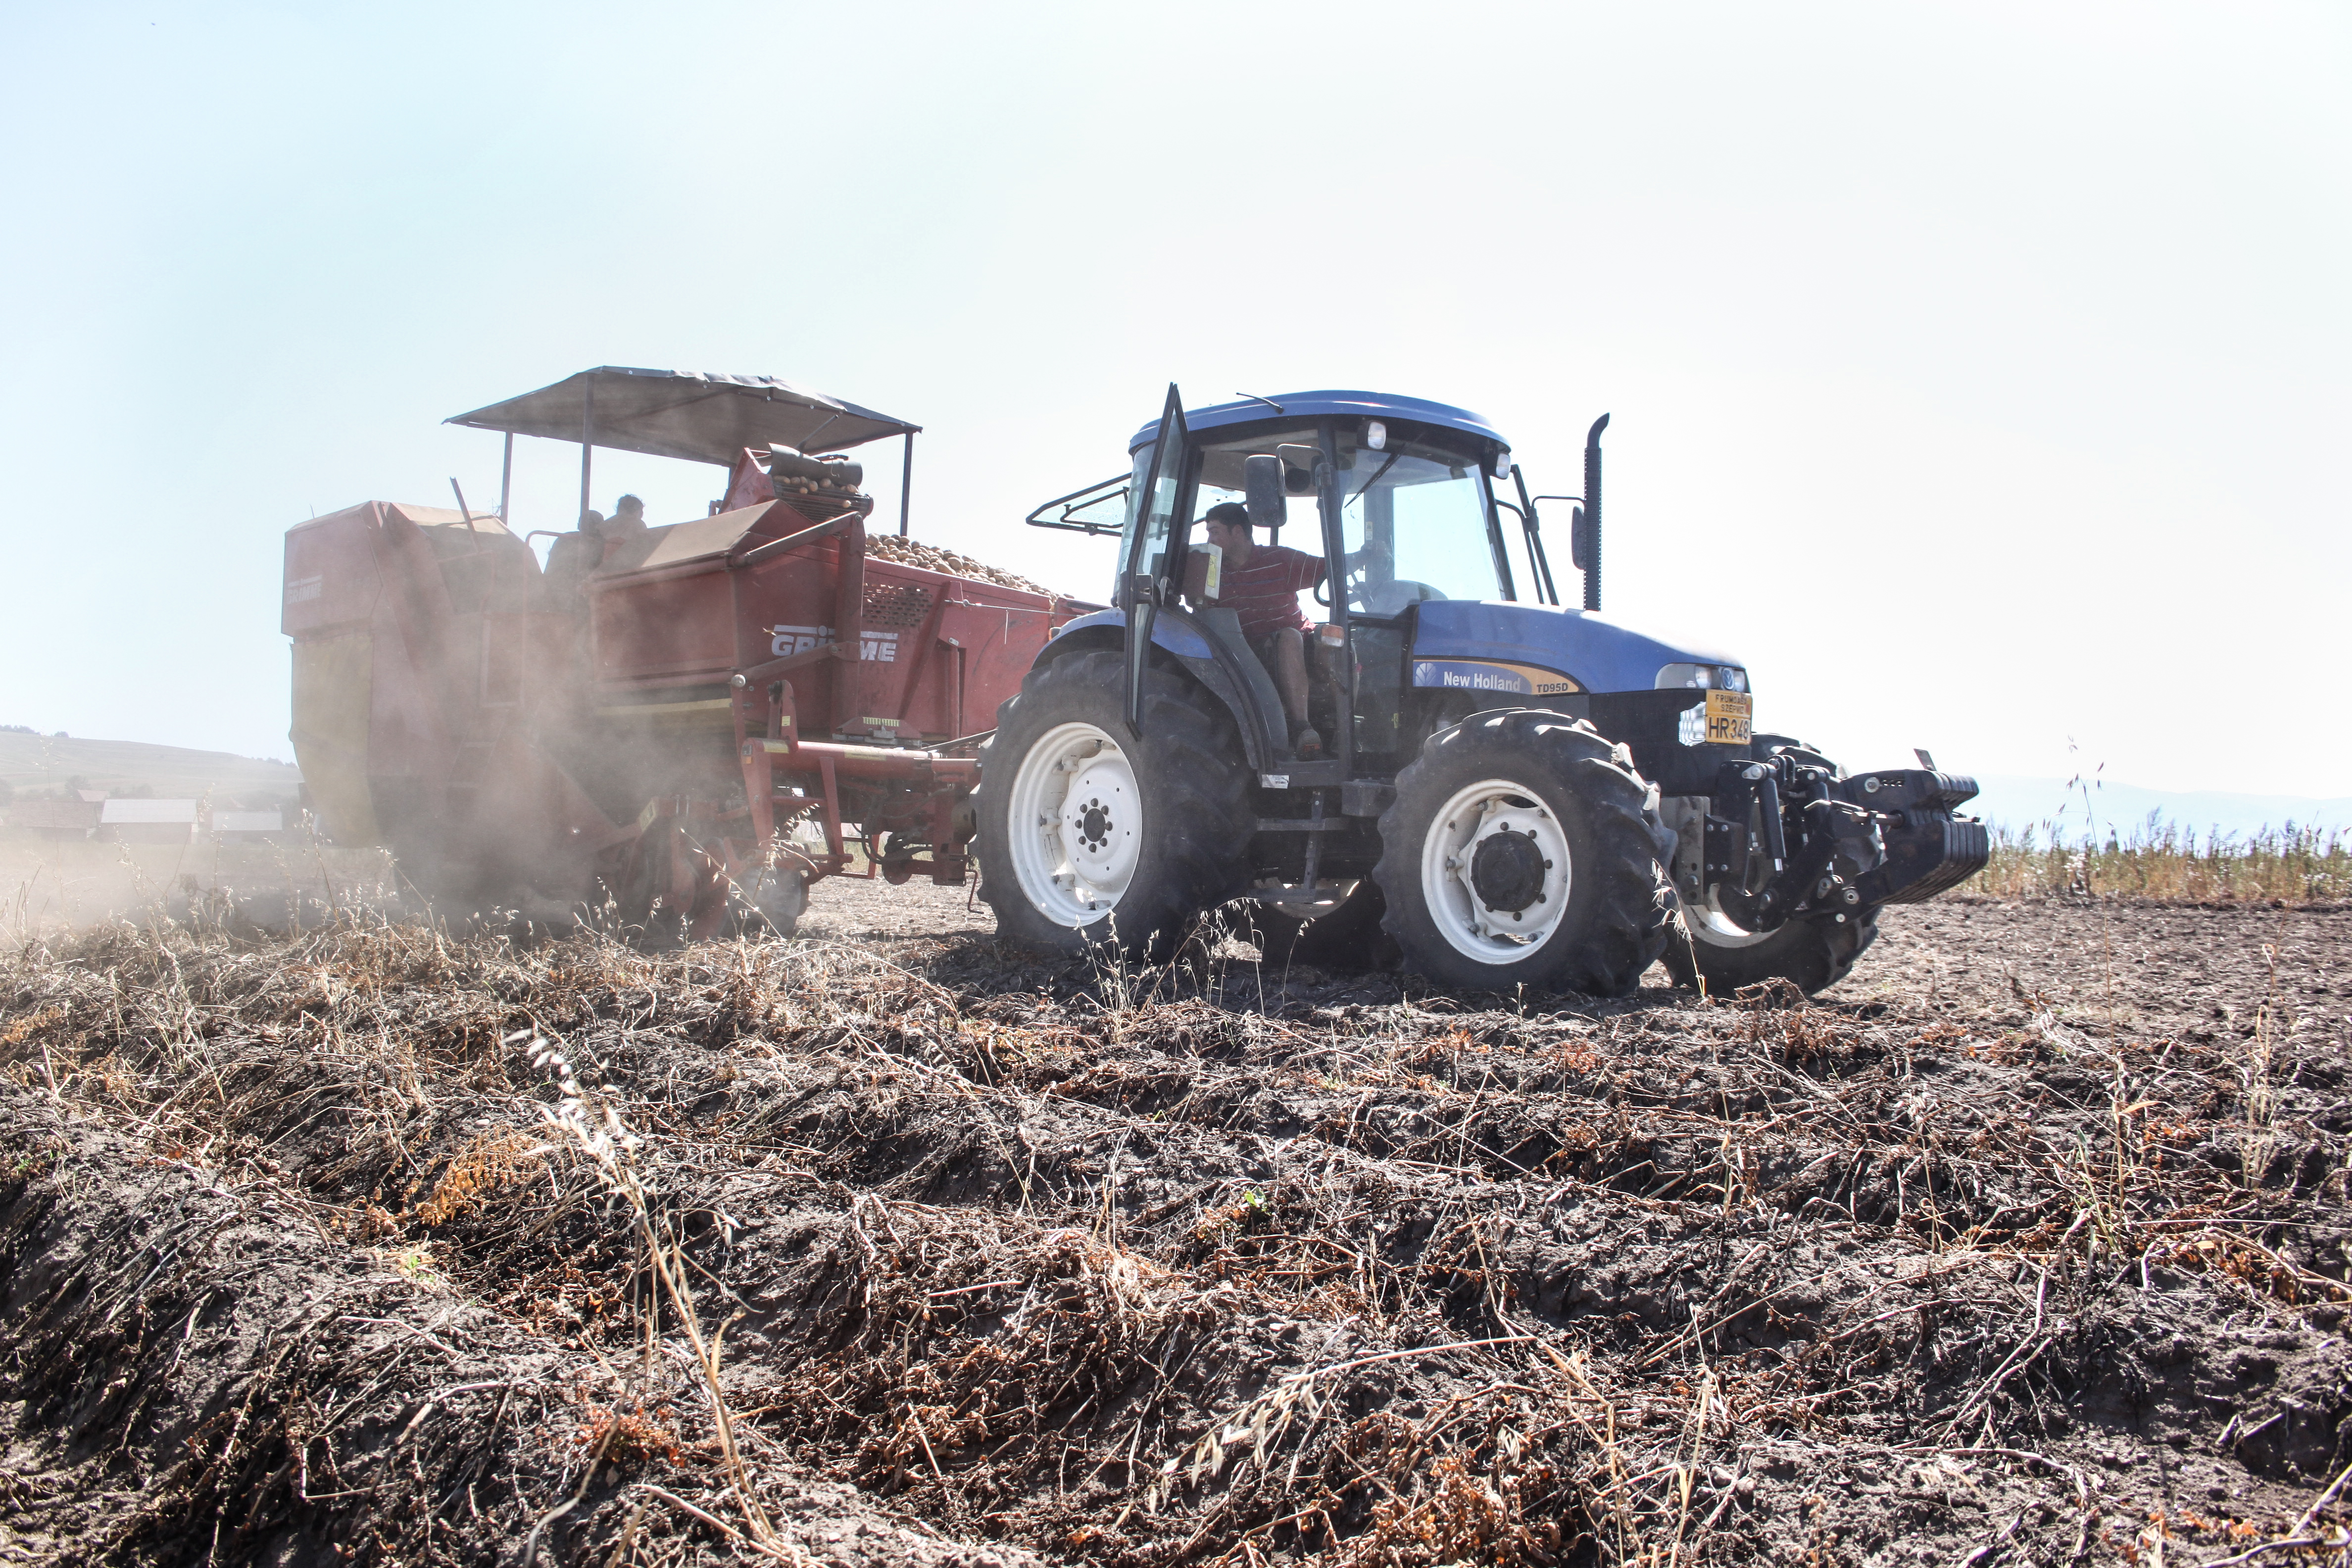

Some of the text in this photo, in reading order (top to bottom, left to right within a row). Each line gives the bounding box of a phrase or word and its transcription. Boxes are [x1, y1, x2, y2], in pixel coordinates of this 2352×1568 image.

[1444, 671, 1520, 692] New Holland
[1537, 683, 1568, 693] TD95D
[1709, 716, 1749, 739] HR348
